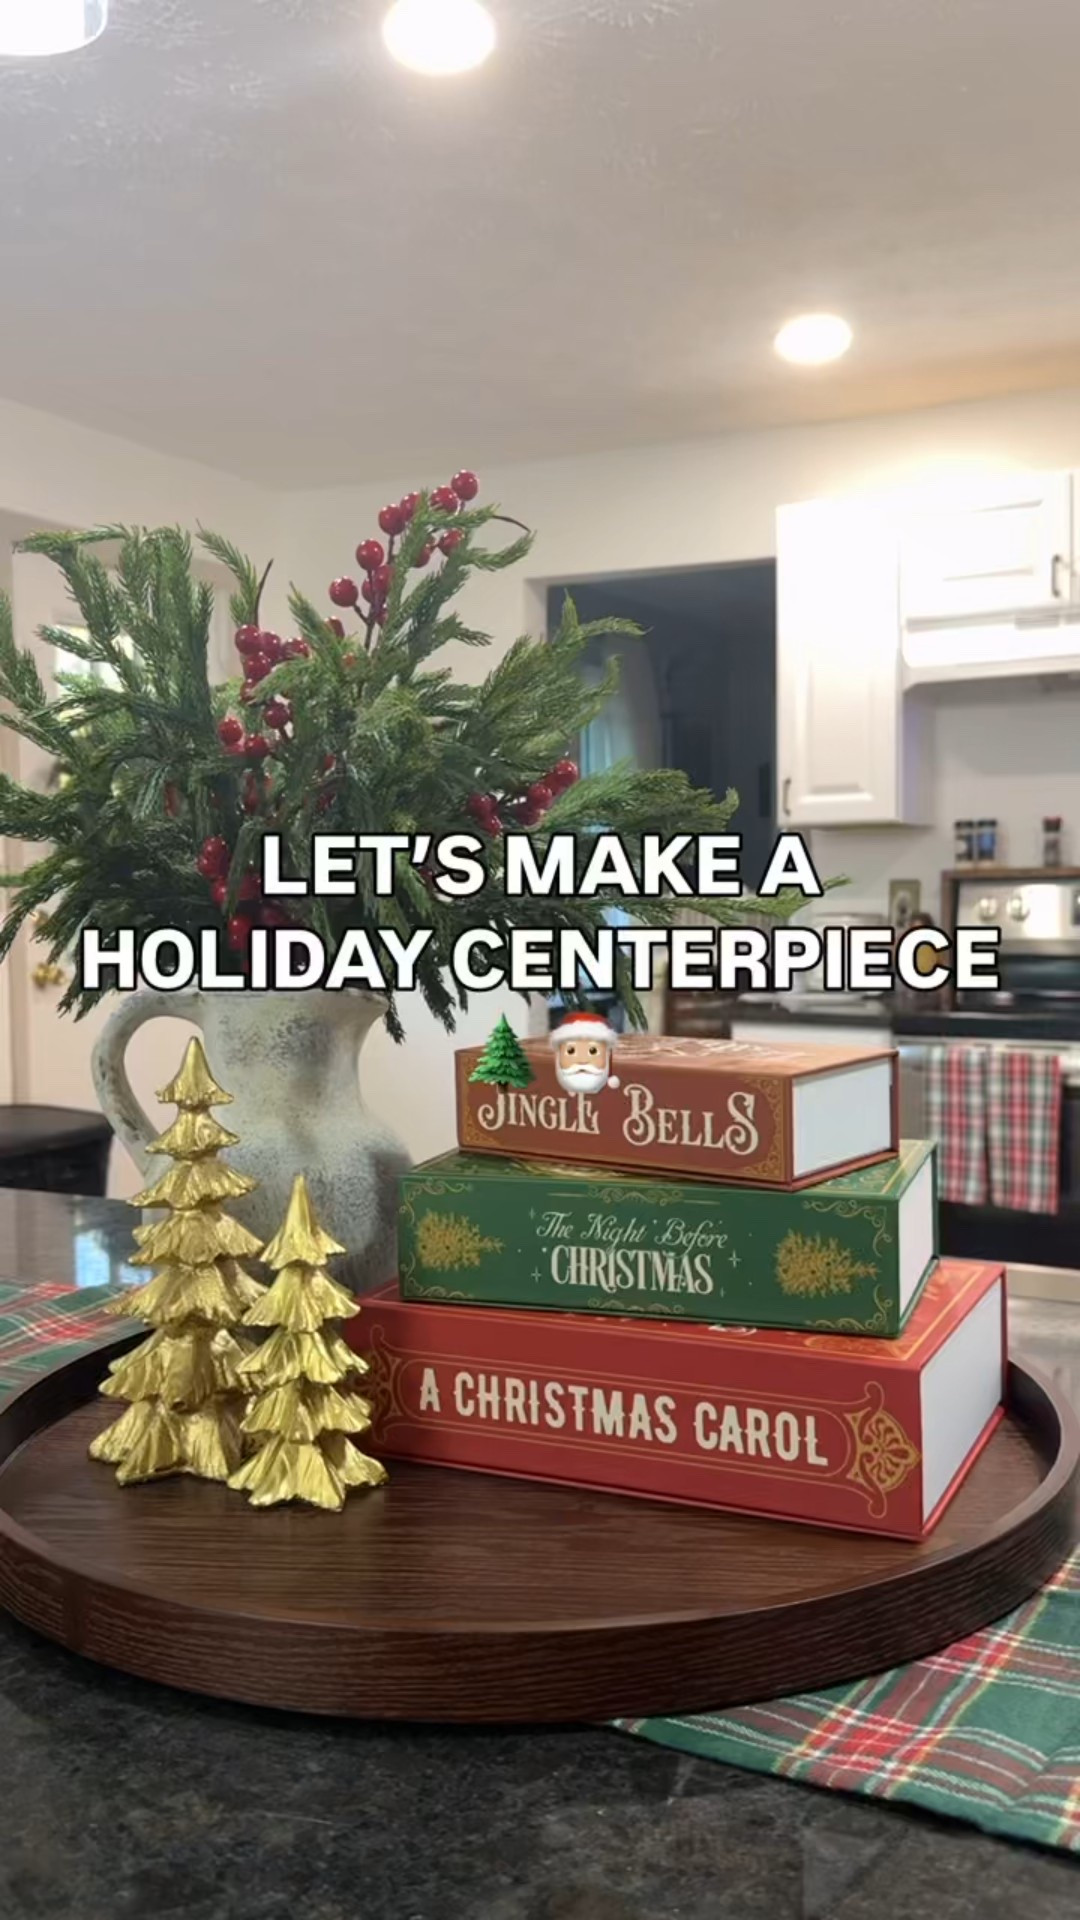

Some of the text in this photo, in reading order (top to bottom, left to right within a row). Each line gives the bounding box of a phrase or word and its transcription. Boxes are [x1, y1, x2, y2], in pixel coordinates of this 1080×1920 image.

[477, 1083, 759, 1156] JINGLE BELLS
[536, 1211, 729, 1259] The Night Before
[551, 1245, 714, 1295] CHRISTMAS
[419, 1367, 829, 1466] A CHRISTMAS CAROL
